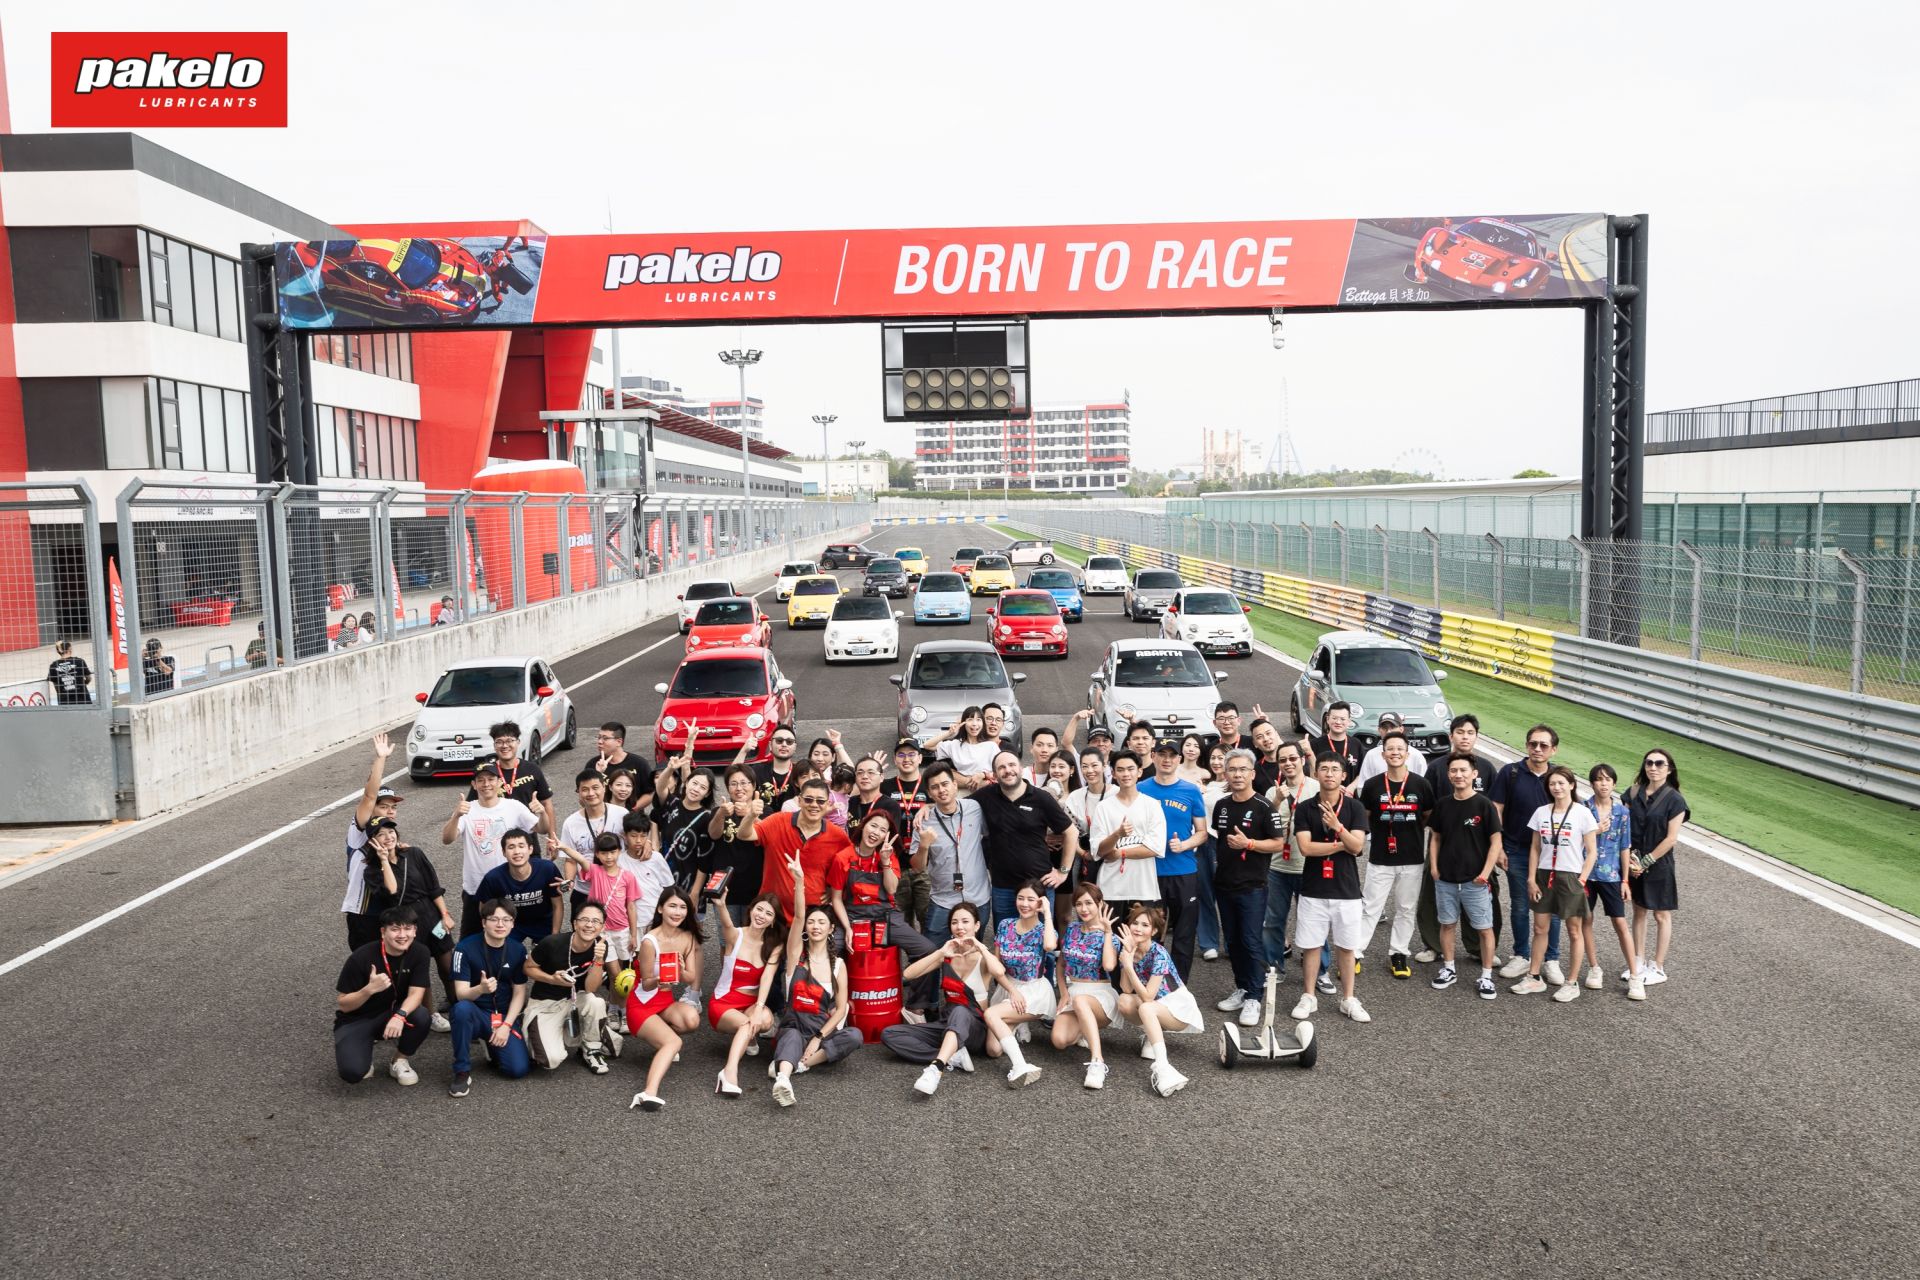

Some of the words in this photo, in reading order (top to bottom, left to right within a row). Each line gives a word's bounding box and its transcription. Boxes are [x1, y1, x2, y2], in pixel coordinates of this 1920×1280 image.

[603, 246, 782, 291] pakelo
[893, 242, 1046, 295] BORN
[1064, 242, 1131, 292] TO
[1146, 237, 1293, 290] RACE
[664, 291, 777, 303] LUBRICANTS
[1345, 286, 1387, 304] Bettega
